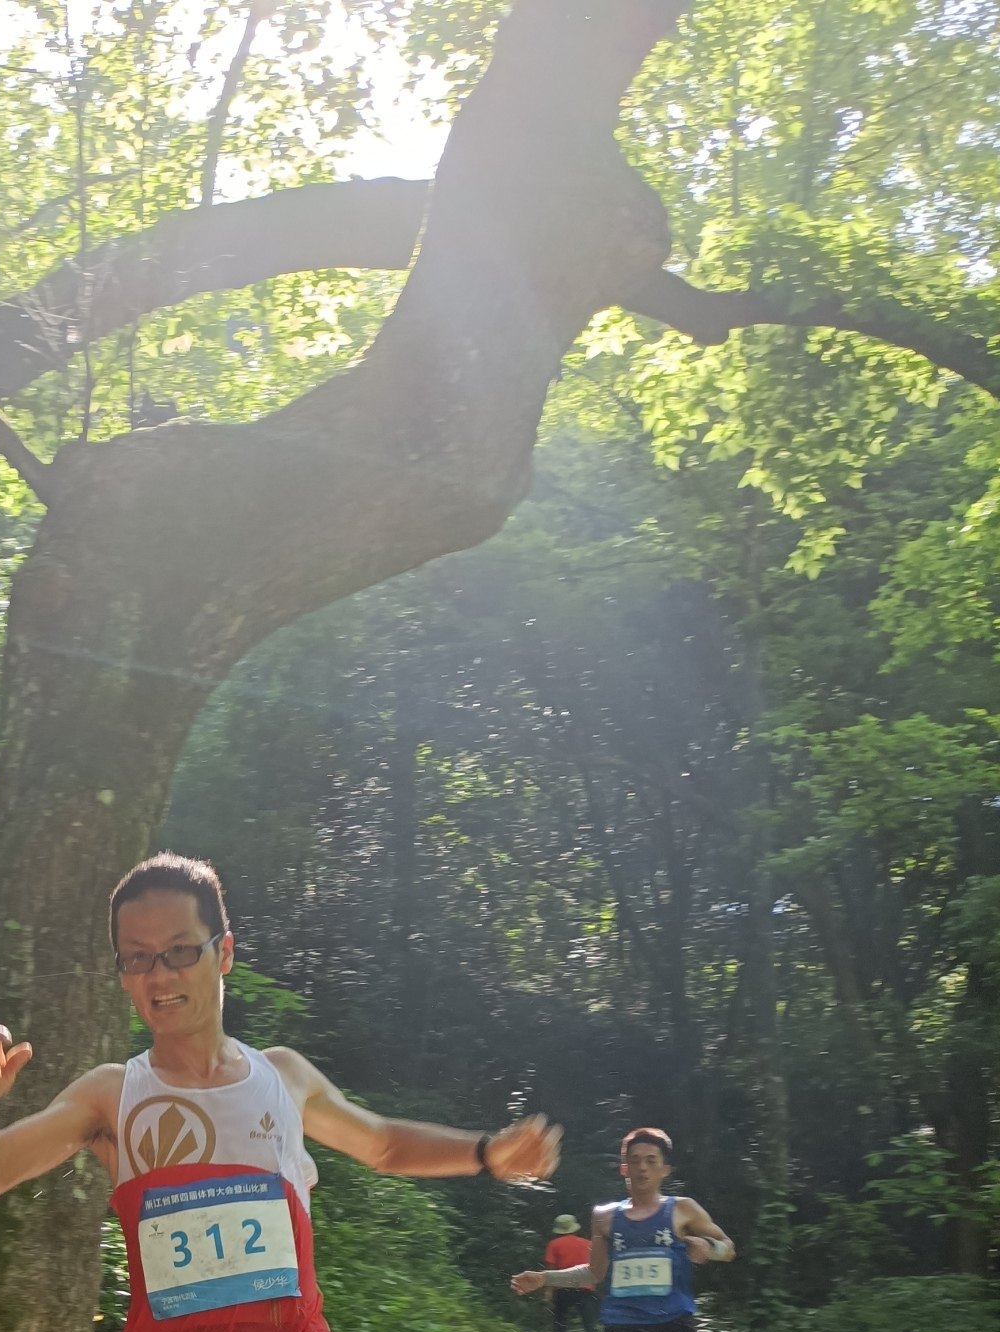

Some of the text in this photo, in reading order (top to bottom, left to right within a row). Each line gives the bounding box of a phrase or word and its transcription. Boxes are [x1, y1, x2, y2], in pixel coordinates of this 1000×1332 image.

[144, 1183, 268, 1211] 浙江省第四届体育大会登山比赛
[170, 1218, 266, 1268] 312
[623, 1265, 659, 1280] 315
